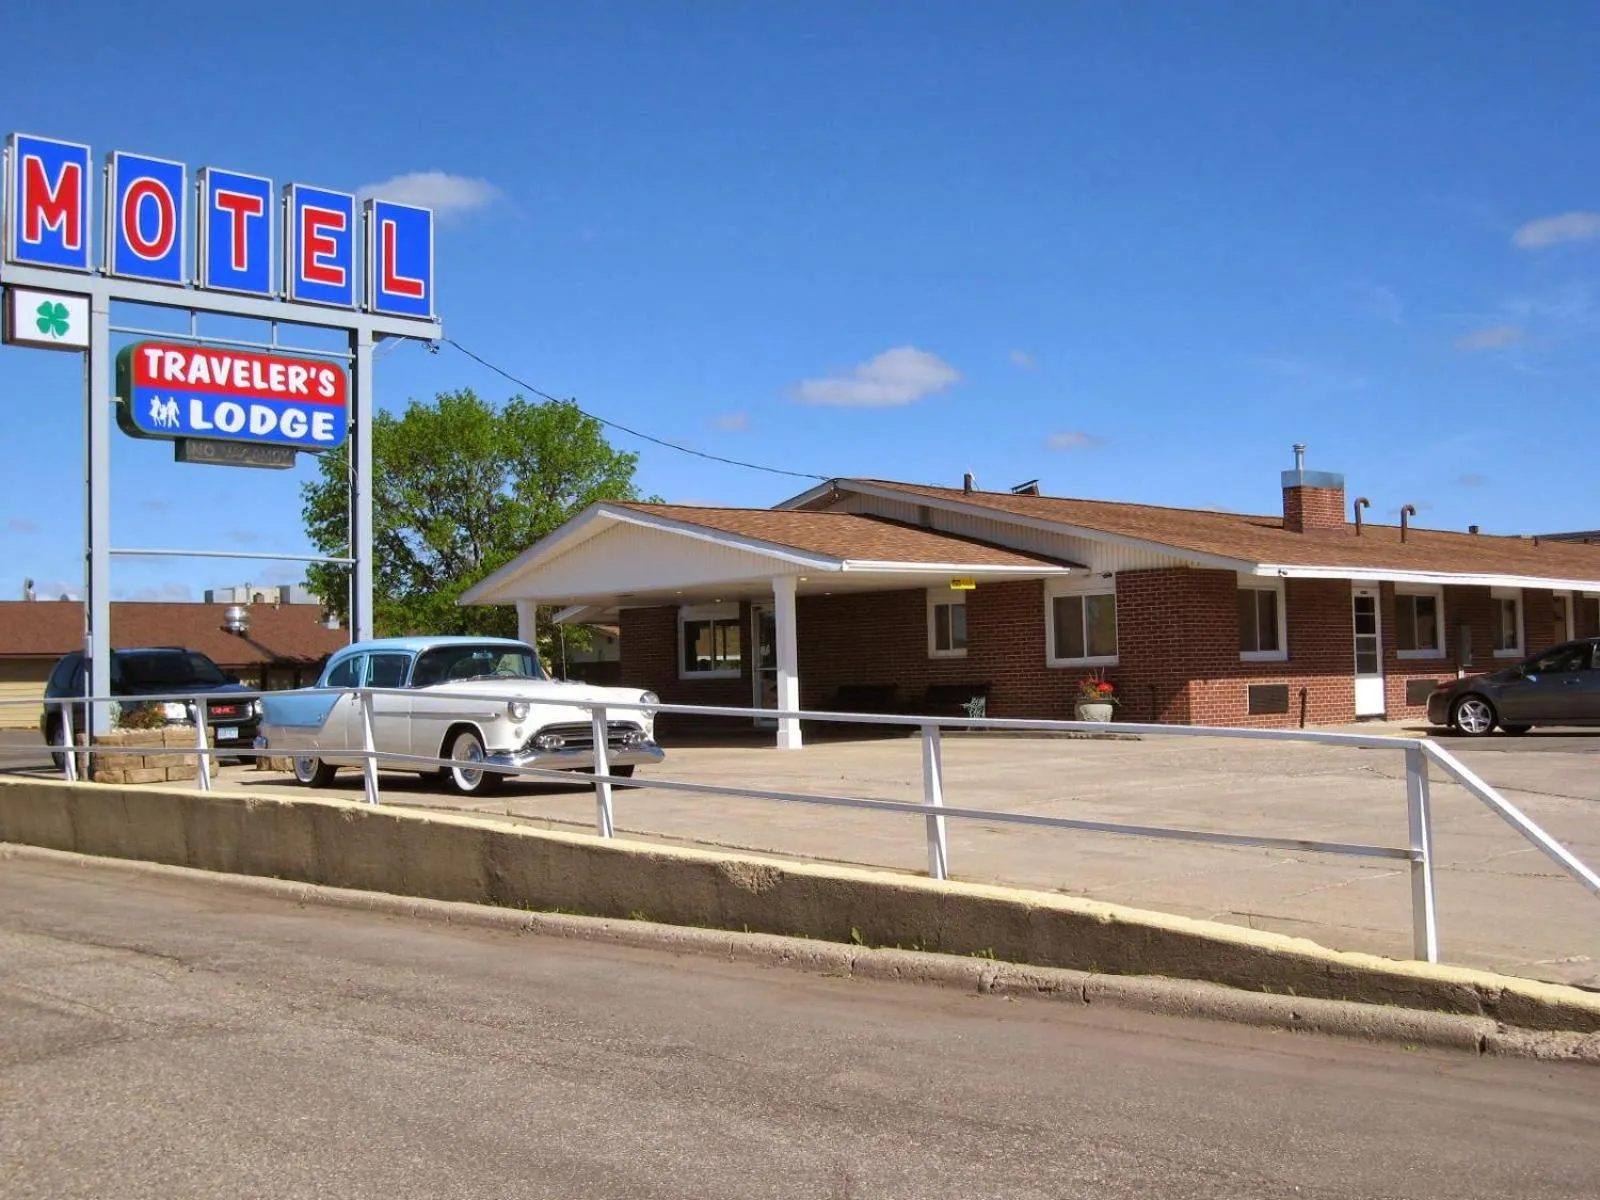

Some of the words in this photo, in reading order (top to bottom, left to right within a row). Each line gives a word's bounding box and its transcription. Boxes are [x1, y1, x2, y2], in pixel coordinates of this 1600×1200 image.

[22, 154, 425, 299] MOTEL
[144, 348, 336, 398] TRAVELER'S
[189, 399, 335, 441] LODGE
